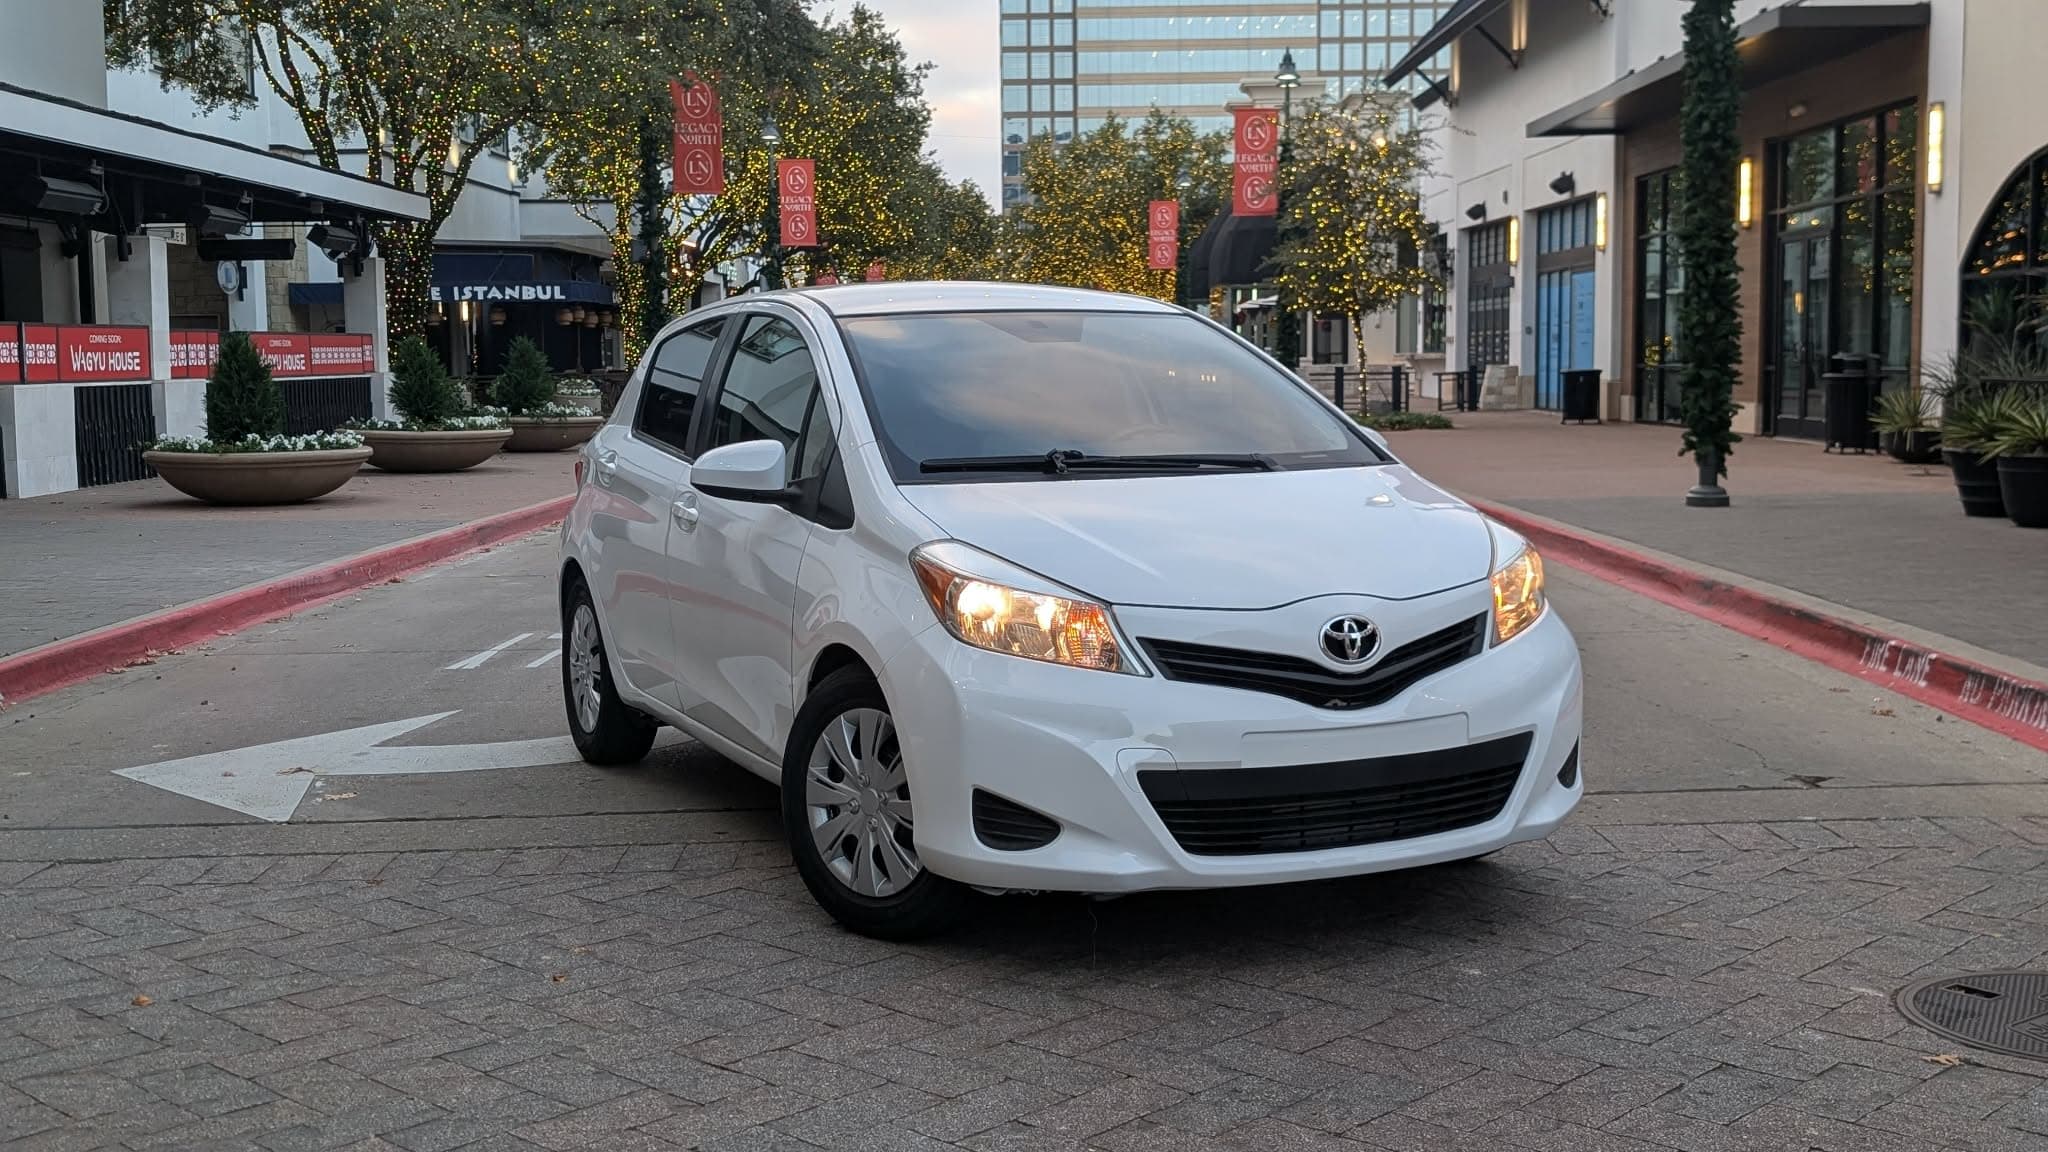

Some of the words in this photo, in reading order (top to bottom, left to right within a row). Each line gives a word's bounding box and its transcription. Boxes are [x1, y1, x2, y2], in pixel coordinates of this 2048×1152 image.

[674, 123, 719, 133] LEGACY
[680, 134, 717, 145] NORTH
[781, 195, 812, 203] LEGACY
[784, 203, 812, 212] NORTH
[453, 285, 567, 300] ISTANBUL
[89, 334, 108, 344] COMING
[70, 344, 106, 372] WAGYU
[108, 351, 141, 371] HOUSE
[282, 353, 306, 371] HOUSE
[1859, 639, 1896, 672] FIRE
[1893, 644, 1938, 688] LANE
[1987, 675, 2048, 732] PARKIN
